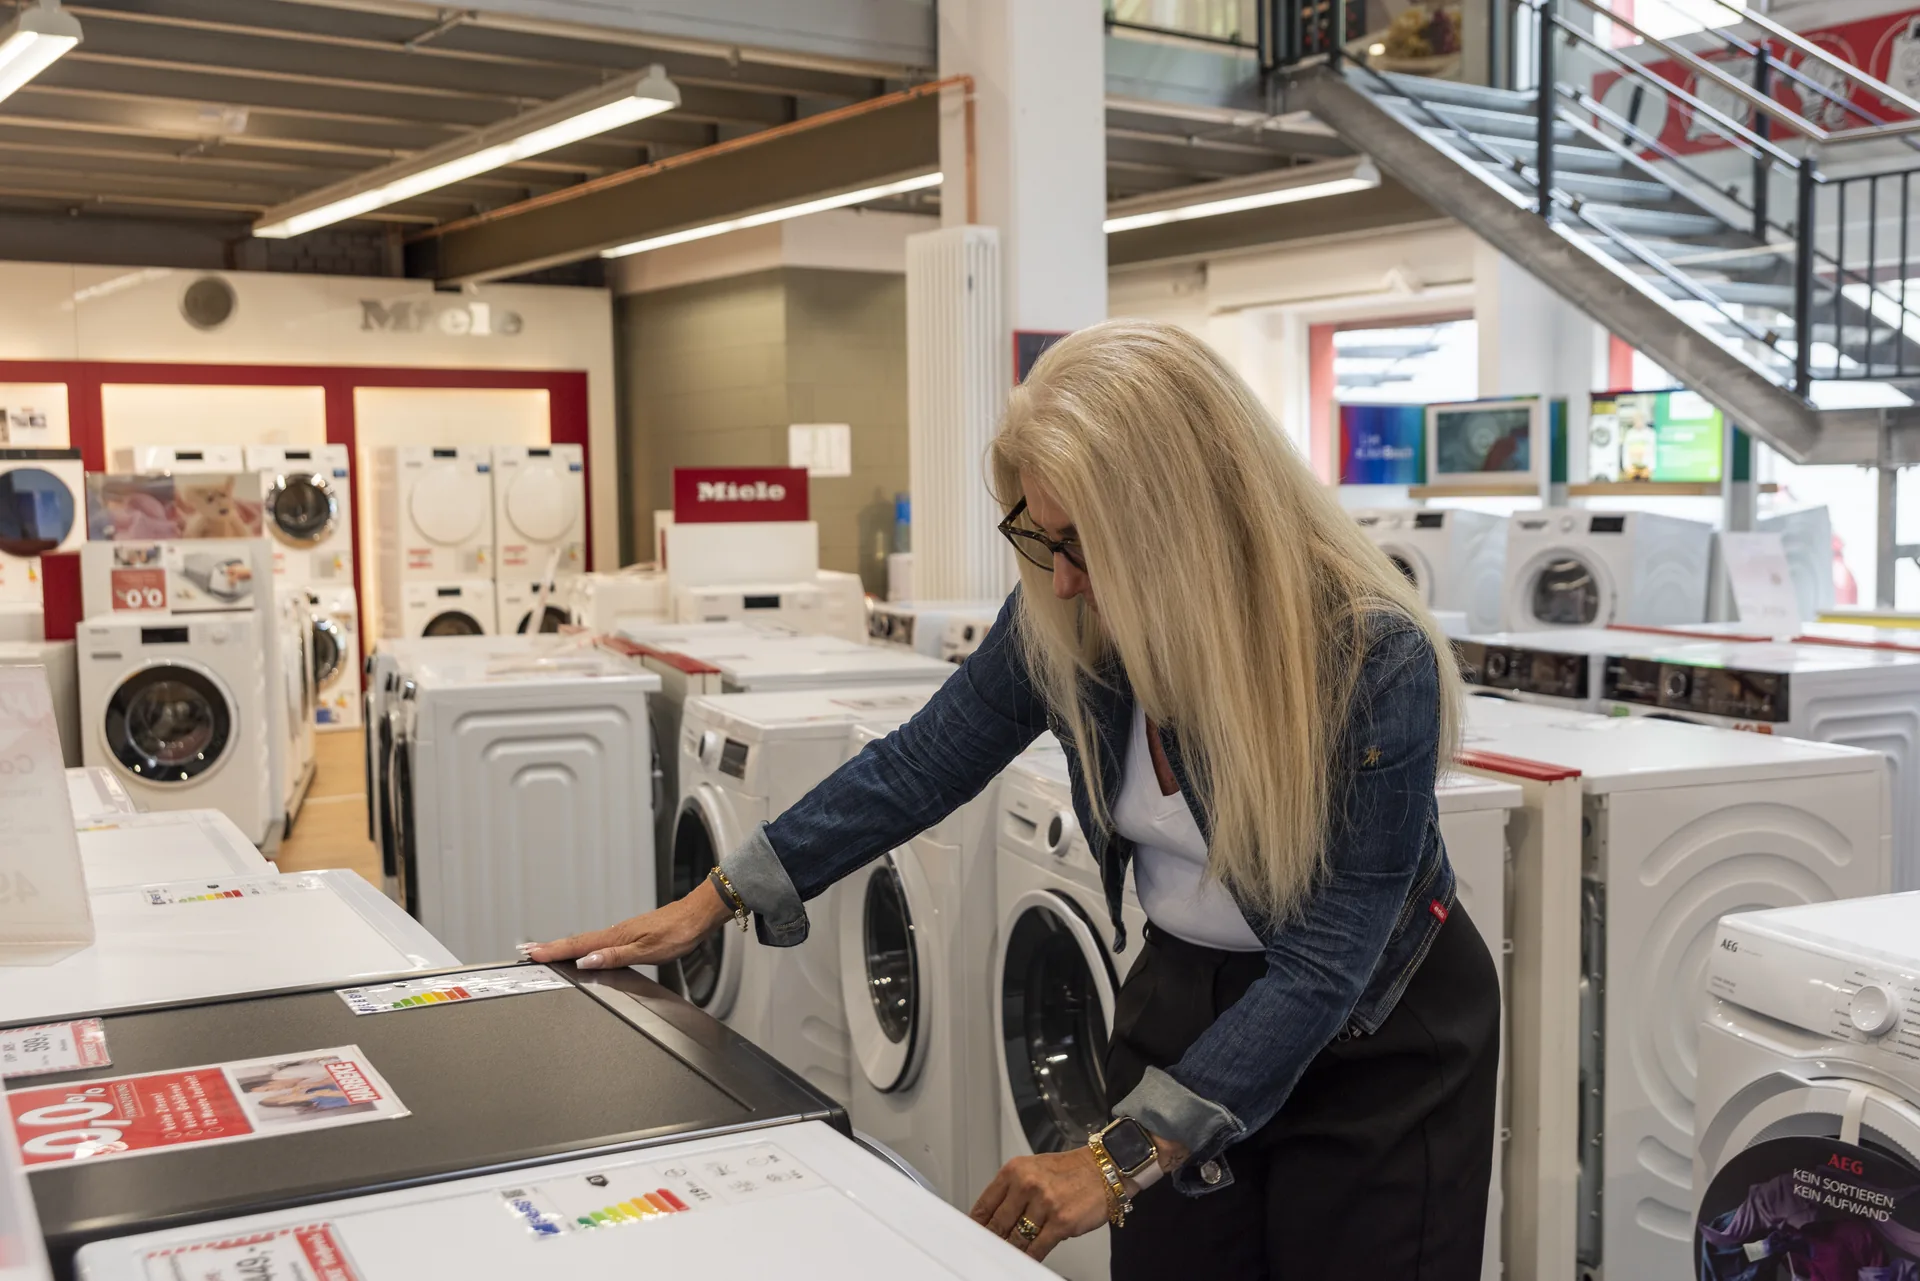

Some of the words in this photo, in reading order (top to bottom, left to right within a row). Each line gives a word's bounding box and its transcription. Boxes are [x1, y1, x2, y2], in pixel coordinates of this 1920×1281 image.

[696, 480, 787, 503] Miele
[1720, 938, 1739, 953] AEG
[327, 1062, 380, 1102] HARBEKE
[114, 1083, 139, 1118] FINANZIERUNG
[17, 1087, 133, 1155] 0,0%
[1828, 1153, 1863, 1175] AEG
[1793, 1168, 1820, 1186] KEIN
[1793, 1183, 1821, 1202] KEIN
